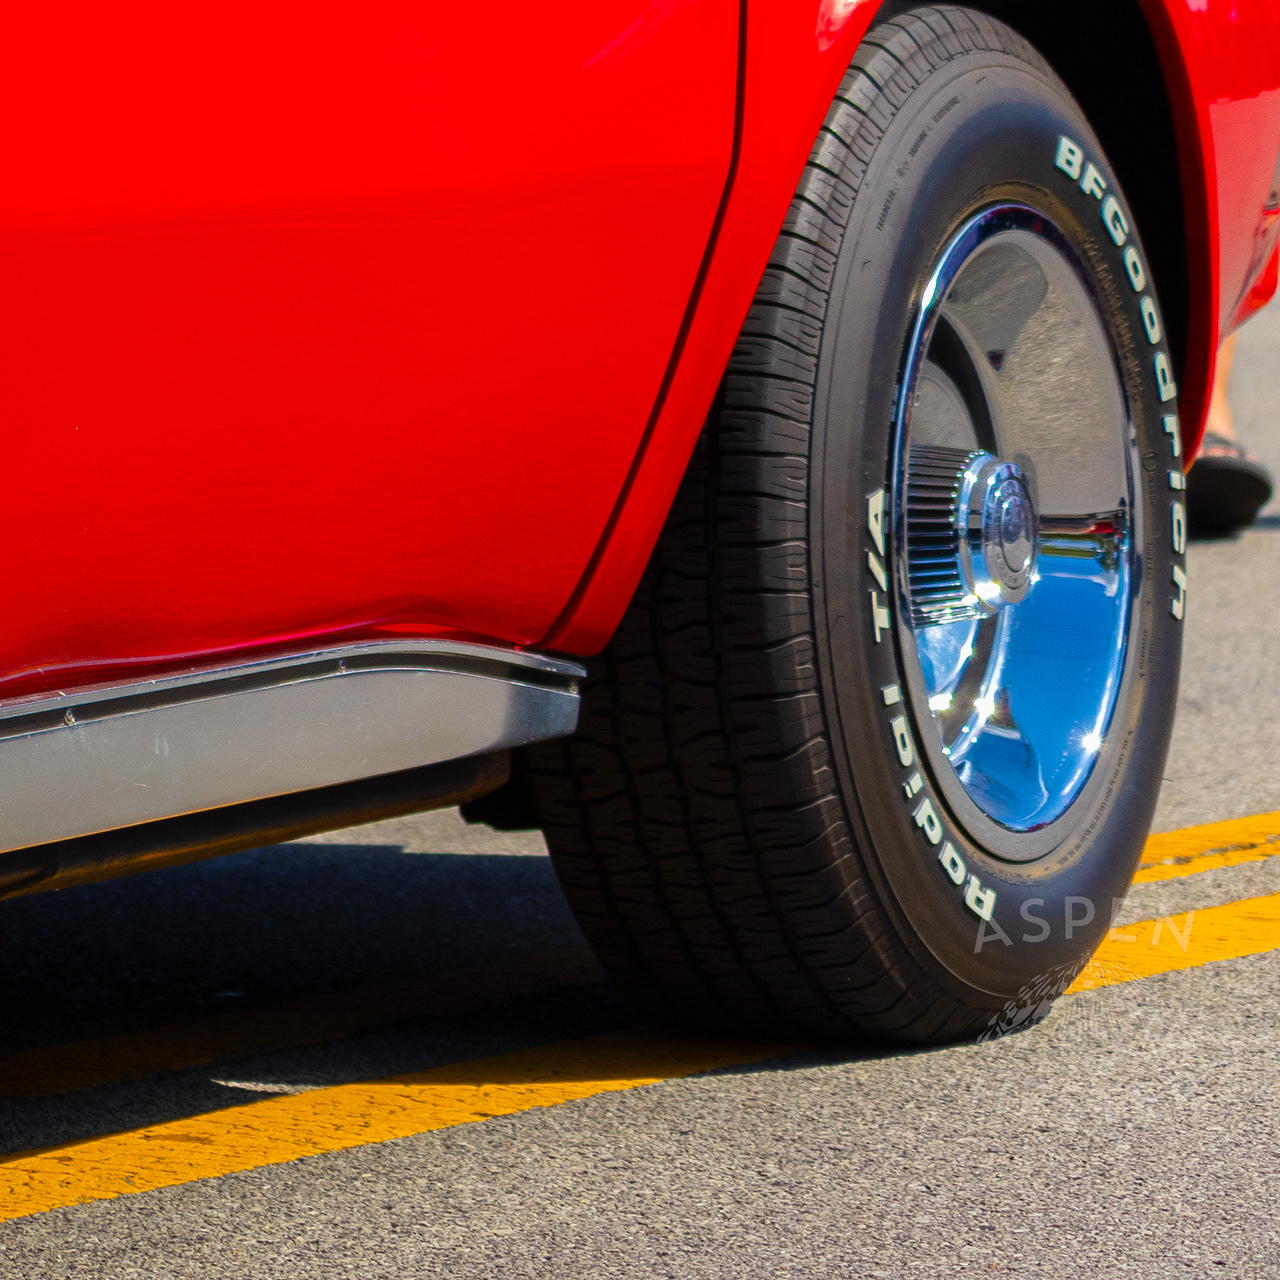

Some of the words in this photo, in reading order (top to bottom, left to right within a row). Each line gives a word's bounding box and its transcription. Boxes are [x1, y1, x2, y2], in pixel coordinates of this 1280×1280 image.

[1054, 134, 1187, 621] BFGoodrich
[867, 488, 891, 644] T/A
[881, 683, 997, 923] Radial
